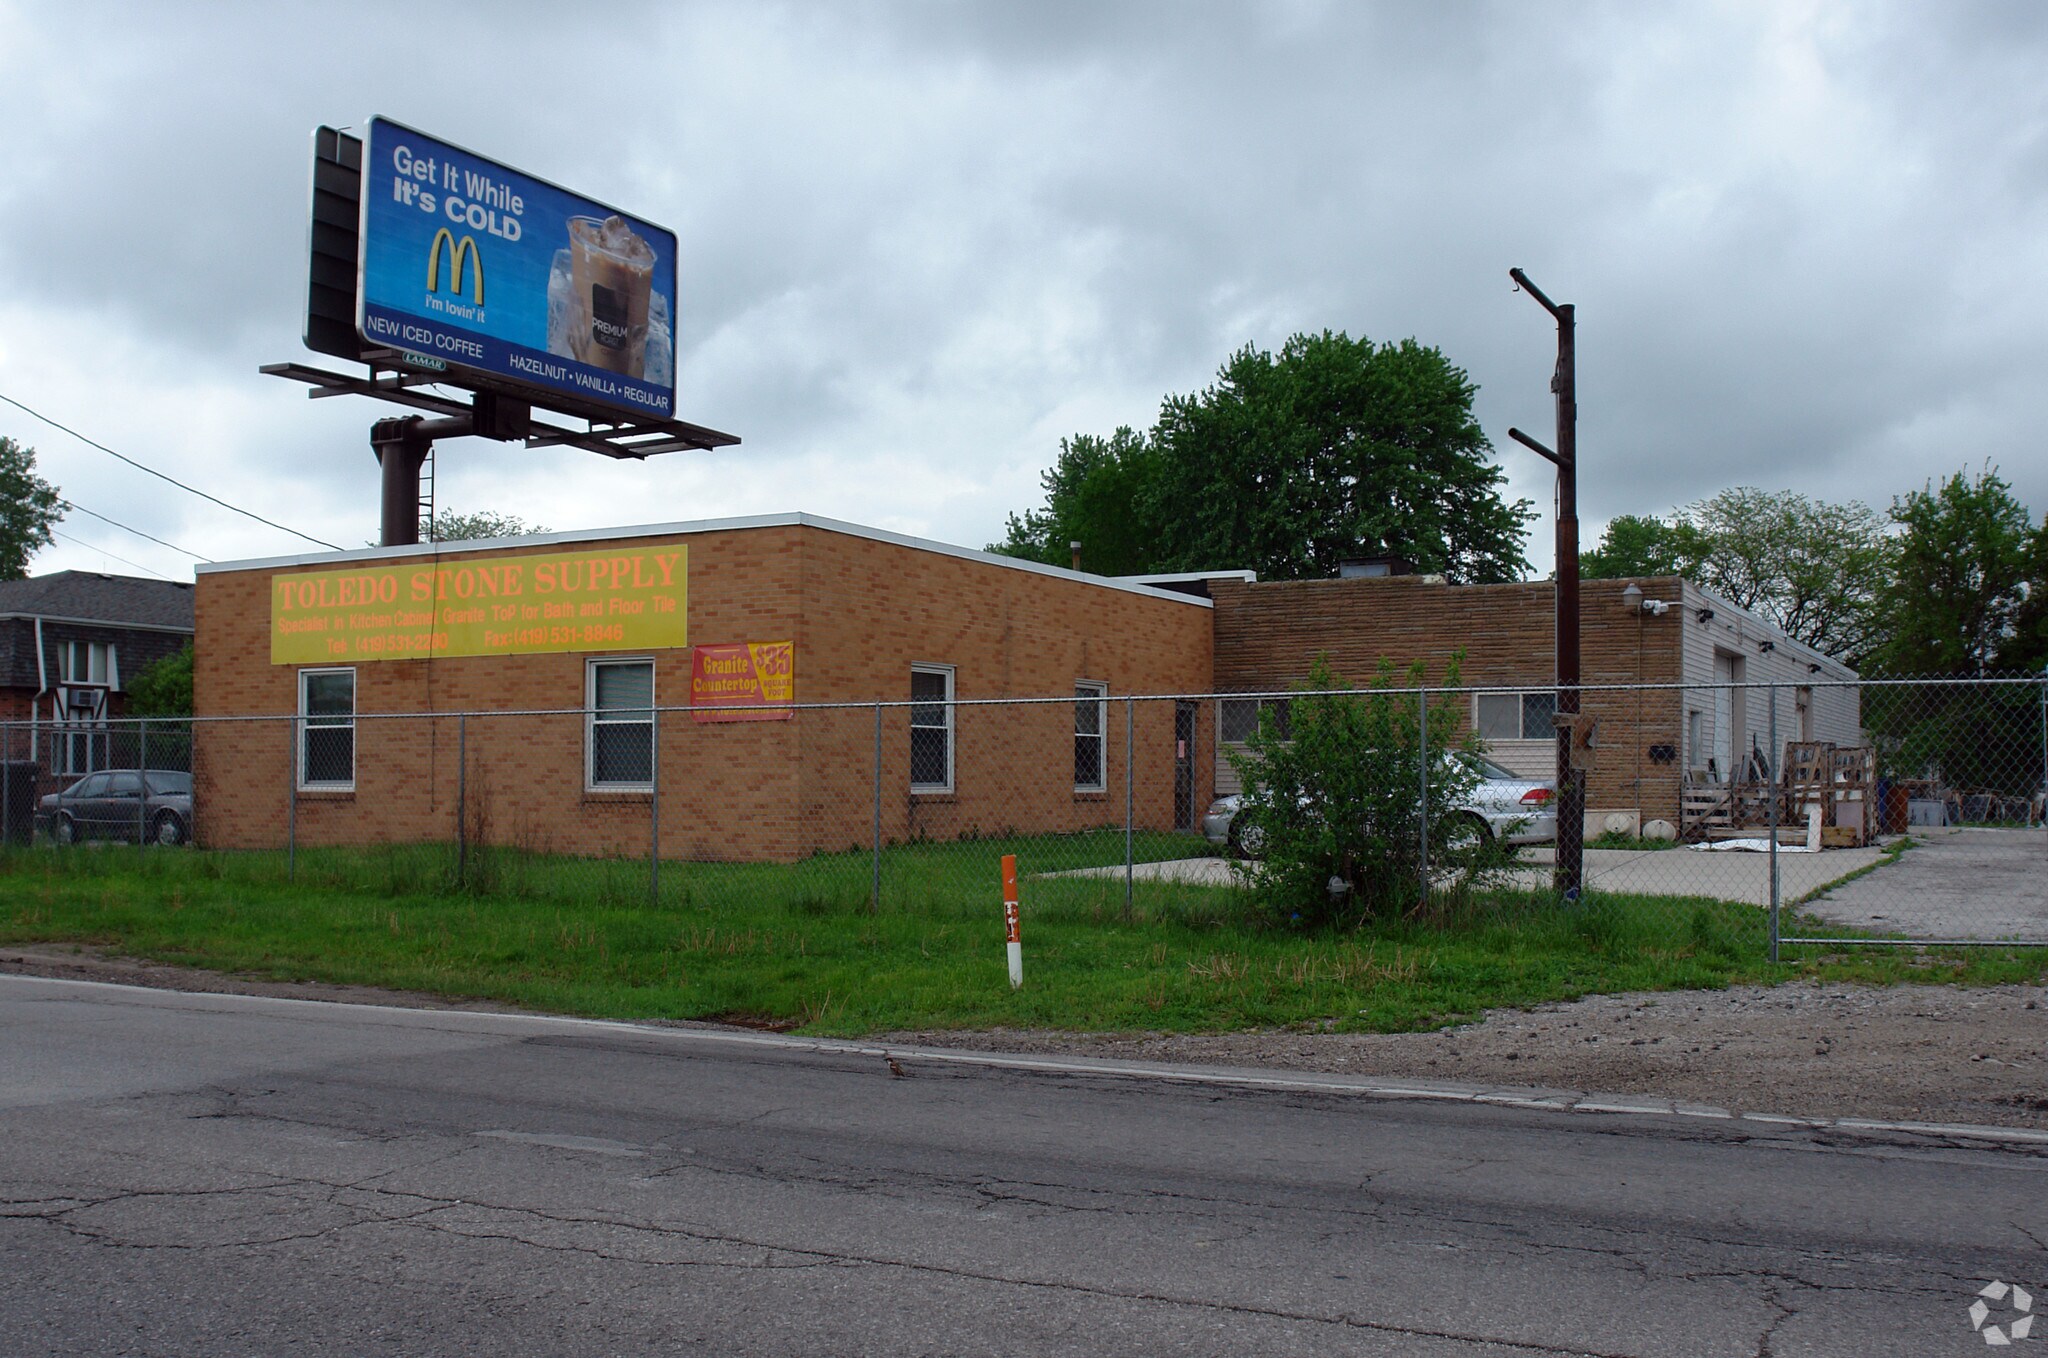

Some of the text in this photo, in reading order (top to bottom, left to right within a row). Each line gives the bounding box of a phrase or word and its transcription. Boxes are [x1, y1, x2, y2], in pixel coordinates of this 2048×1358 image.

[393, 145, 524, 216] Get It While
[393, 176, 522, 242] It's COLD
[425, 294, 486, 324] i'm lovin' it
[592, 316, 628, 338] PREMIUM
[367, 315, 484, 359] NEW ICED COFFEE
[405, 353, 442, 369] LAMAR
[509, 353, 669, 410] HAZELNUT VANILLA REGULAR
[278, 553, 681, 611] TOLEDO STONE SUPPLY
[278, 616, 328, 635] Specialist
[334, 614, 345, 630] in
[350, 611, 392, 630] Kitchen
[394, 609, 437, 627] Cabinet
[442, 607, 485, 624] Granite
[521, 603, 539, 621] for
[543, 601, 575, 619] Bath
[579, 600, 603, 617] and
[609, 597, 645, 616] Floor
[652, 595, 676, 613] Tile
[703, 655, 748, 675] Granite
[693, 677, 758, 694] Countertop
